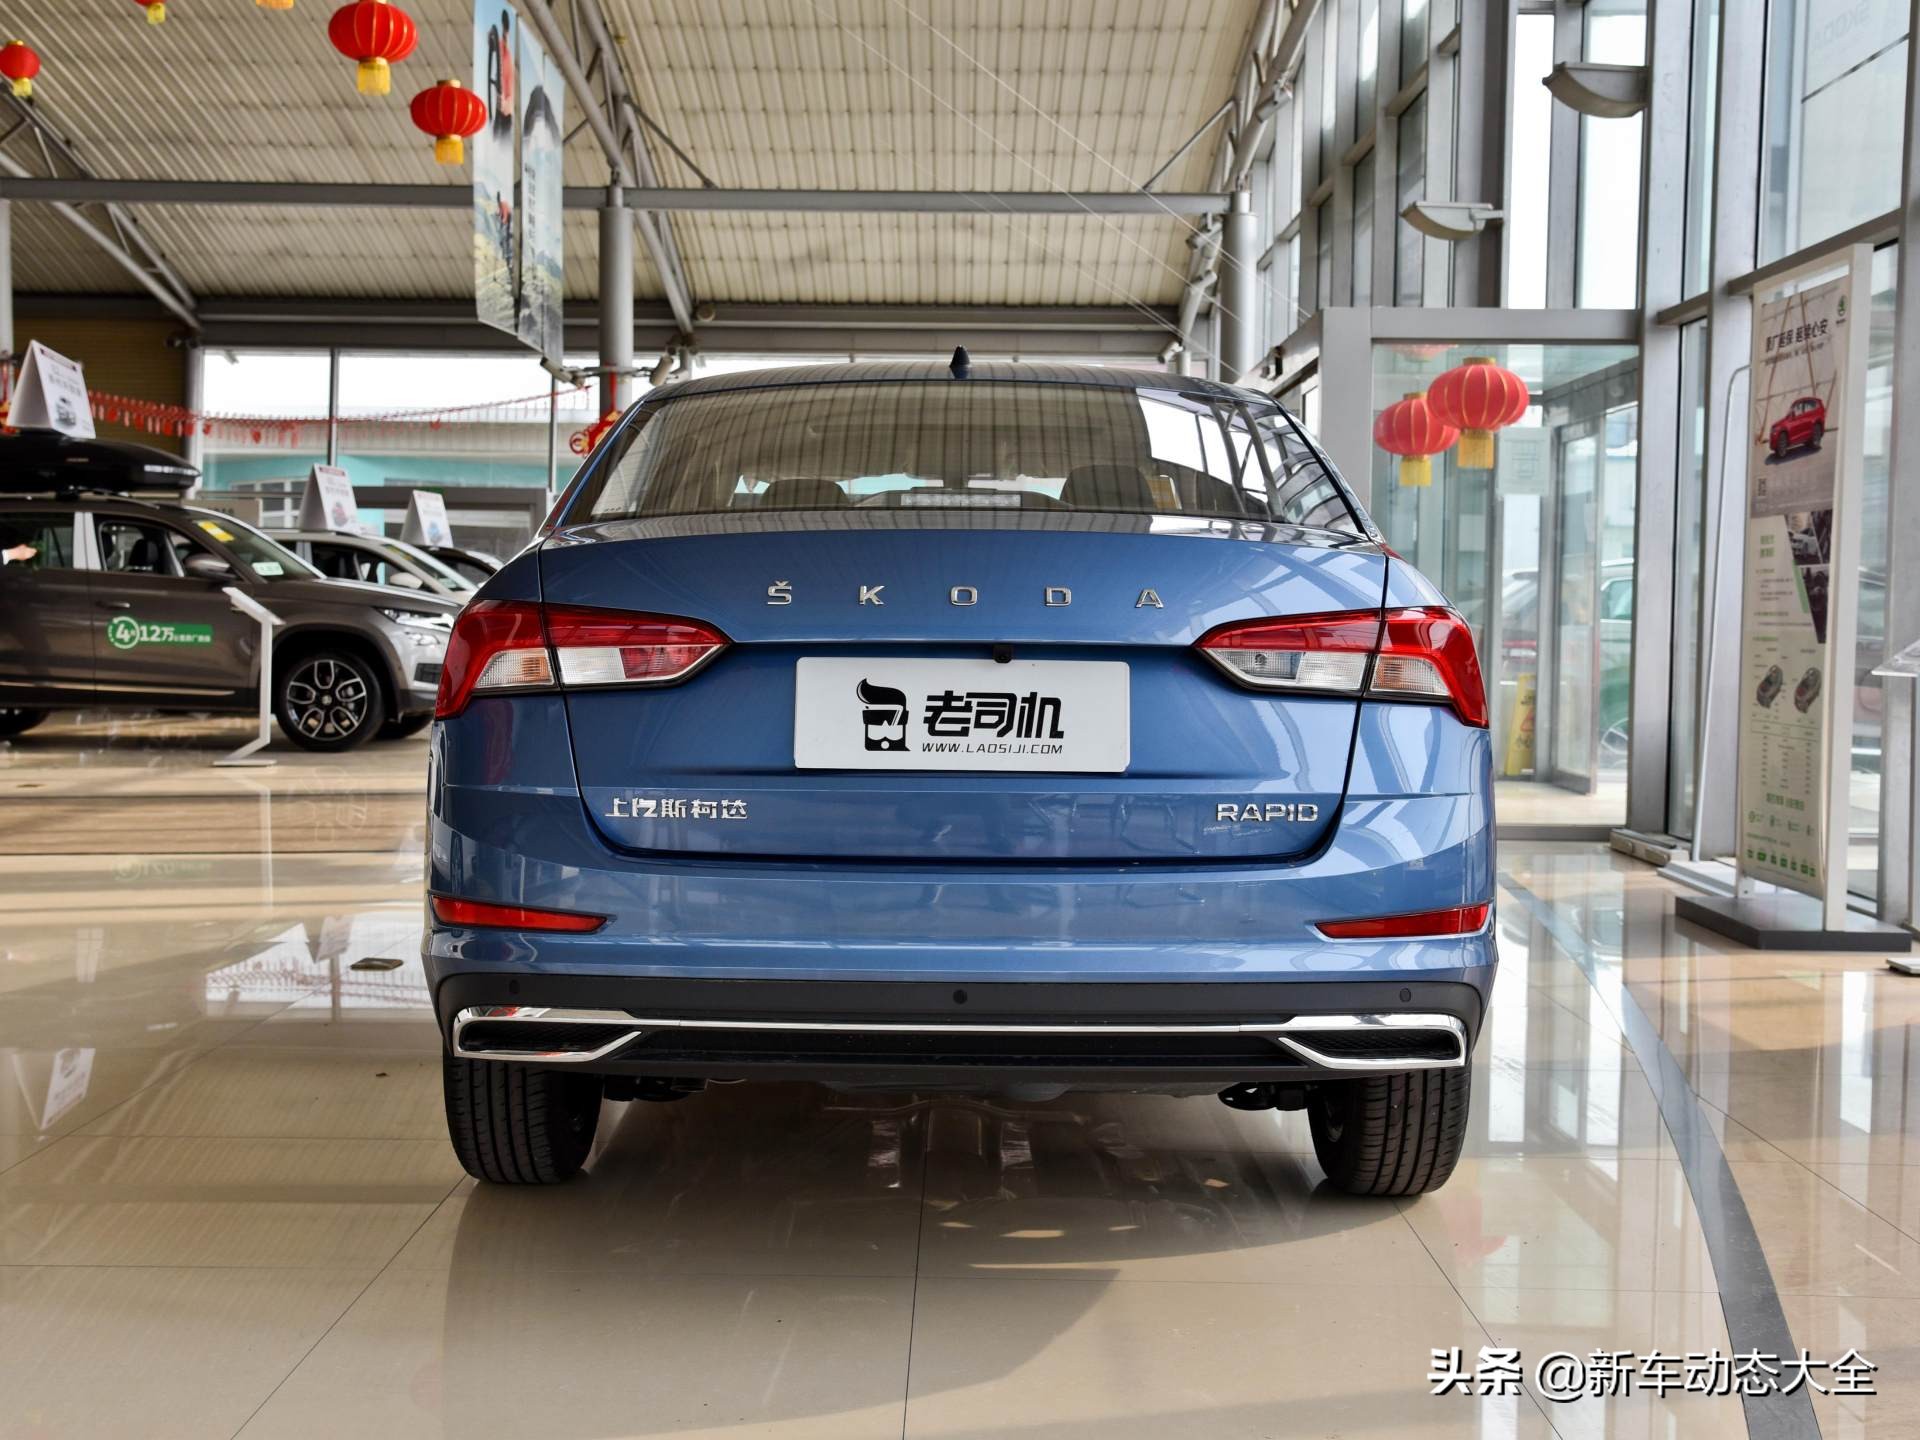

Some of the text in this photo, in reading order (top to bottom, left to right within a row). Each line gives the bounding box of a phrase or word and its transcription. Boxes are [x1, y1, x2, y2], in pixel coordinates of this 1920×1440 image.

[767, 580, 1165, 608] ŠKODA
[923, 690, 1065, 739] 老司机
[922, 742, 1063, 755] WWW.LAOSIJI.COM
[604, 797, 748, 819] 上汽斯柯达
[1216, 803, 1319, 822] RAPID
